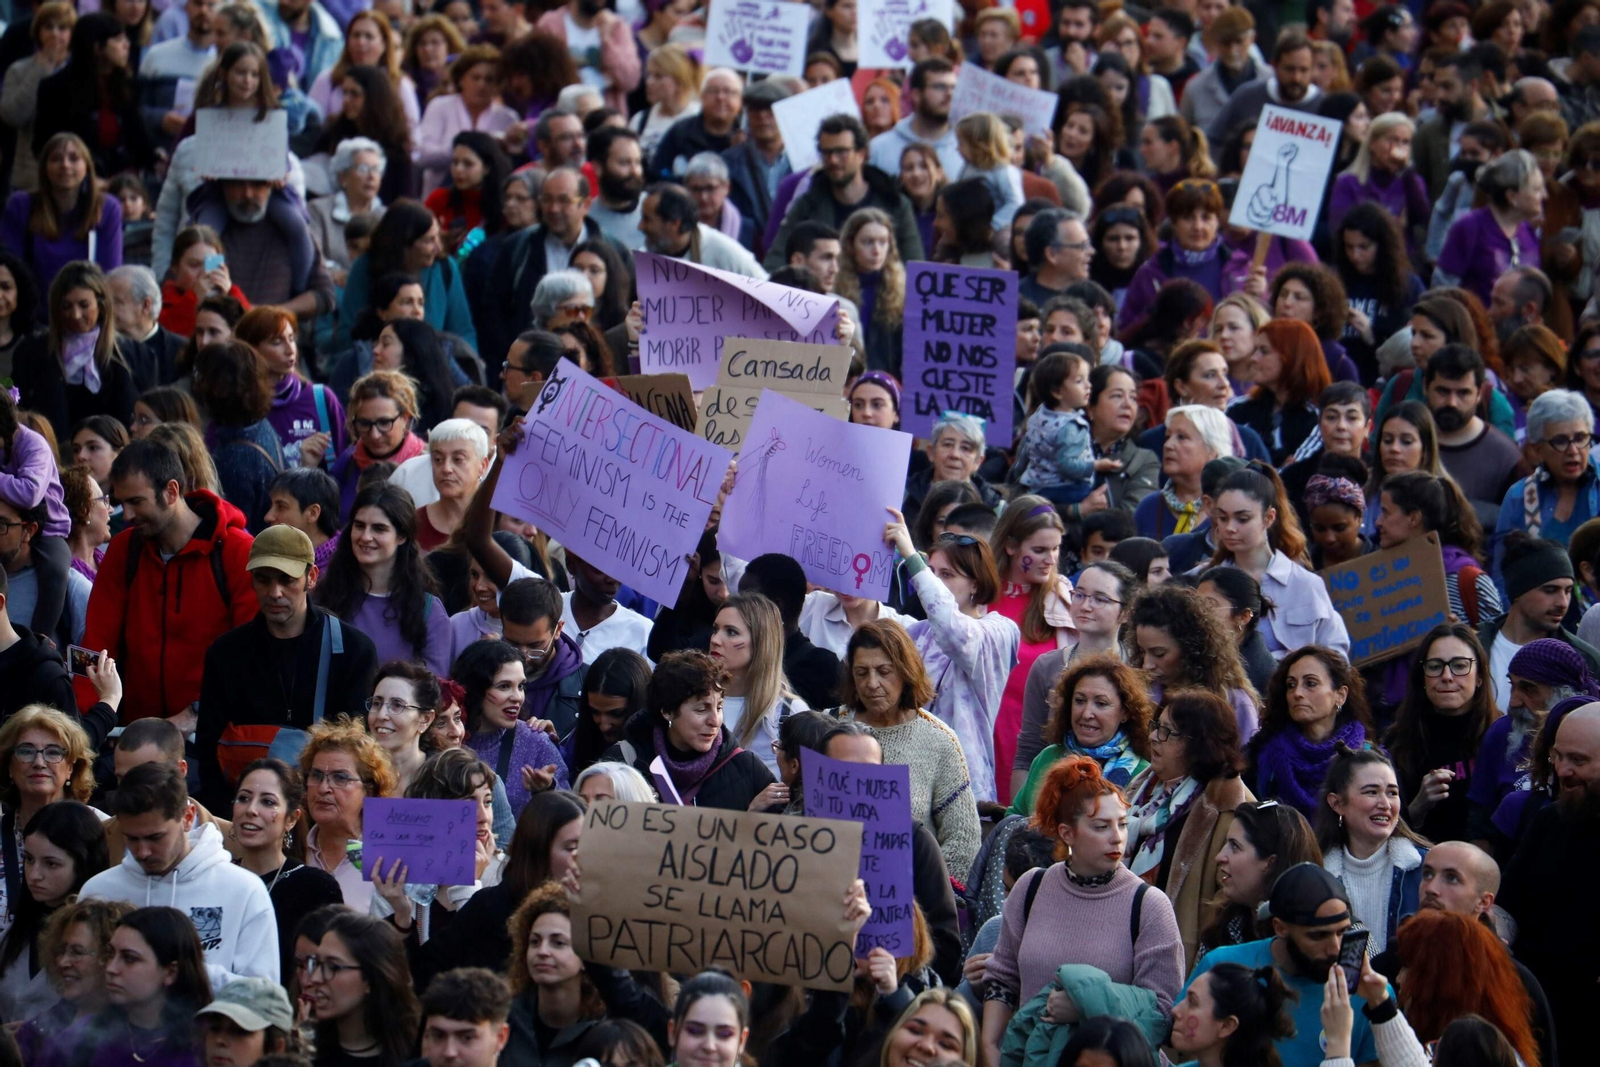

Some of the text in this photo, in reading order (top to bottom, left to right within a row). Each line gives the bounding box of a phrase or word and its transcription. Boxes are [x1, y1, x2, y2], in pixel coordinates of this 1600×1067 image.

[1272, 203, 1308, 227] 8M
[652, 258, 690, 284] NO
[915, 270, 1007, 306] QUE SER
[644, 294, 724, 325] MUJER
[921, 308, 998, 338] MUJER
[727, 350, 833, 383] Cansada
[924, 340, 998, 369] NO NOS
[921, 367, 998, 397] CUESTE
[915, 391, 941, 417] LA
[549, 375, 714, 506] INTERSECTIONAL
[526, 419, 690, 529] FEMINISM IS THE
[804, 437, 864, 482] Women
[795, 478, 829, 522] Life
[518, 461, 681, 586] ONLY FEMINISM
[817, 766, 824, 786] A
[856, 778, 901, 800] MUJER
[827, 796, 843, 815] TU
[849, 802, 879, 821] VIDA
[589, 804, 837, 855] NO ES UN CASO
[658, 840, 799, 894] AISLADO
[643, 884, 787, 926] SE LLAMA
[587, 915, 854, 984] PATRIARCADO
